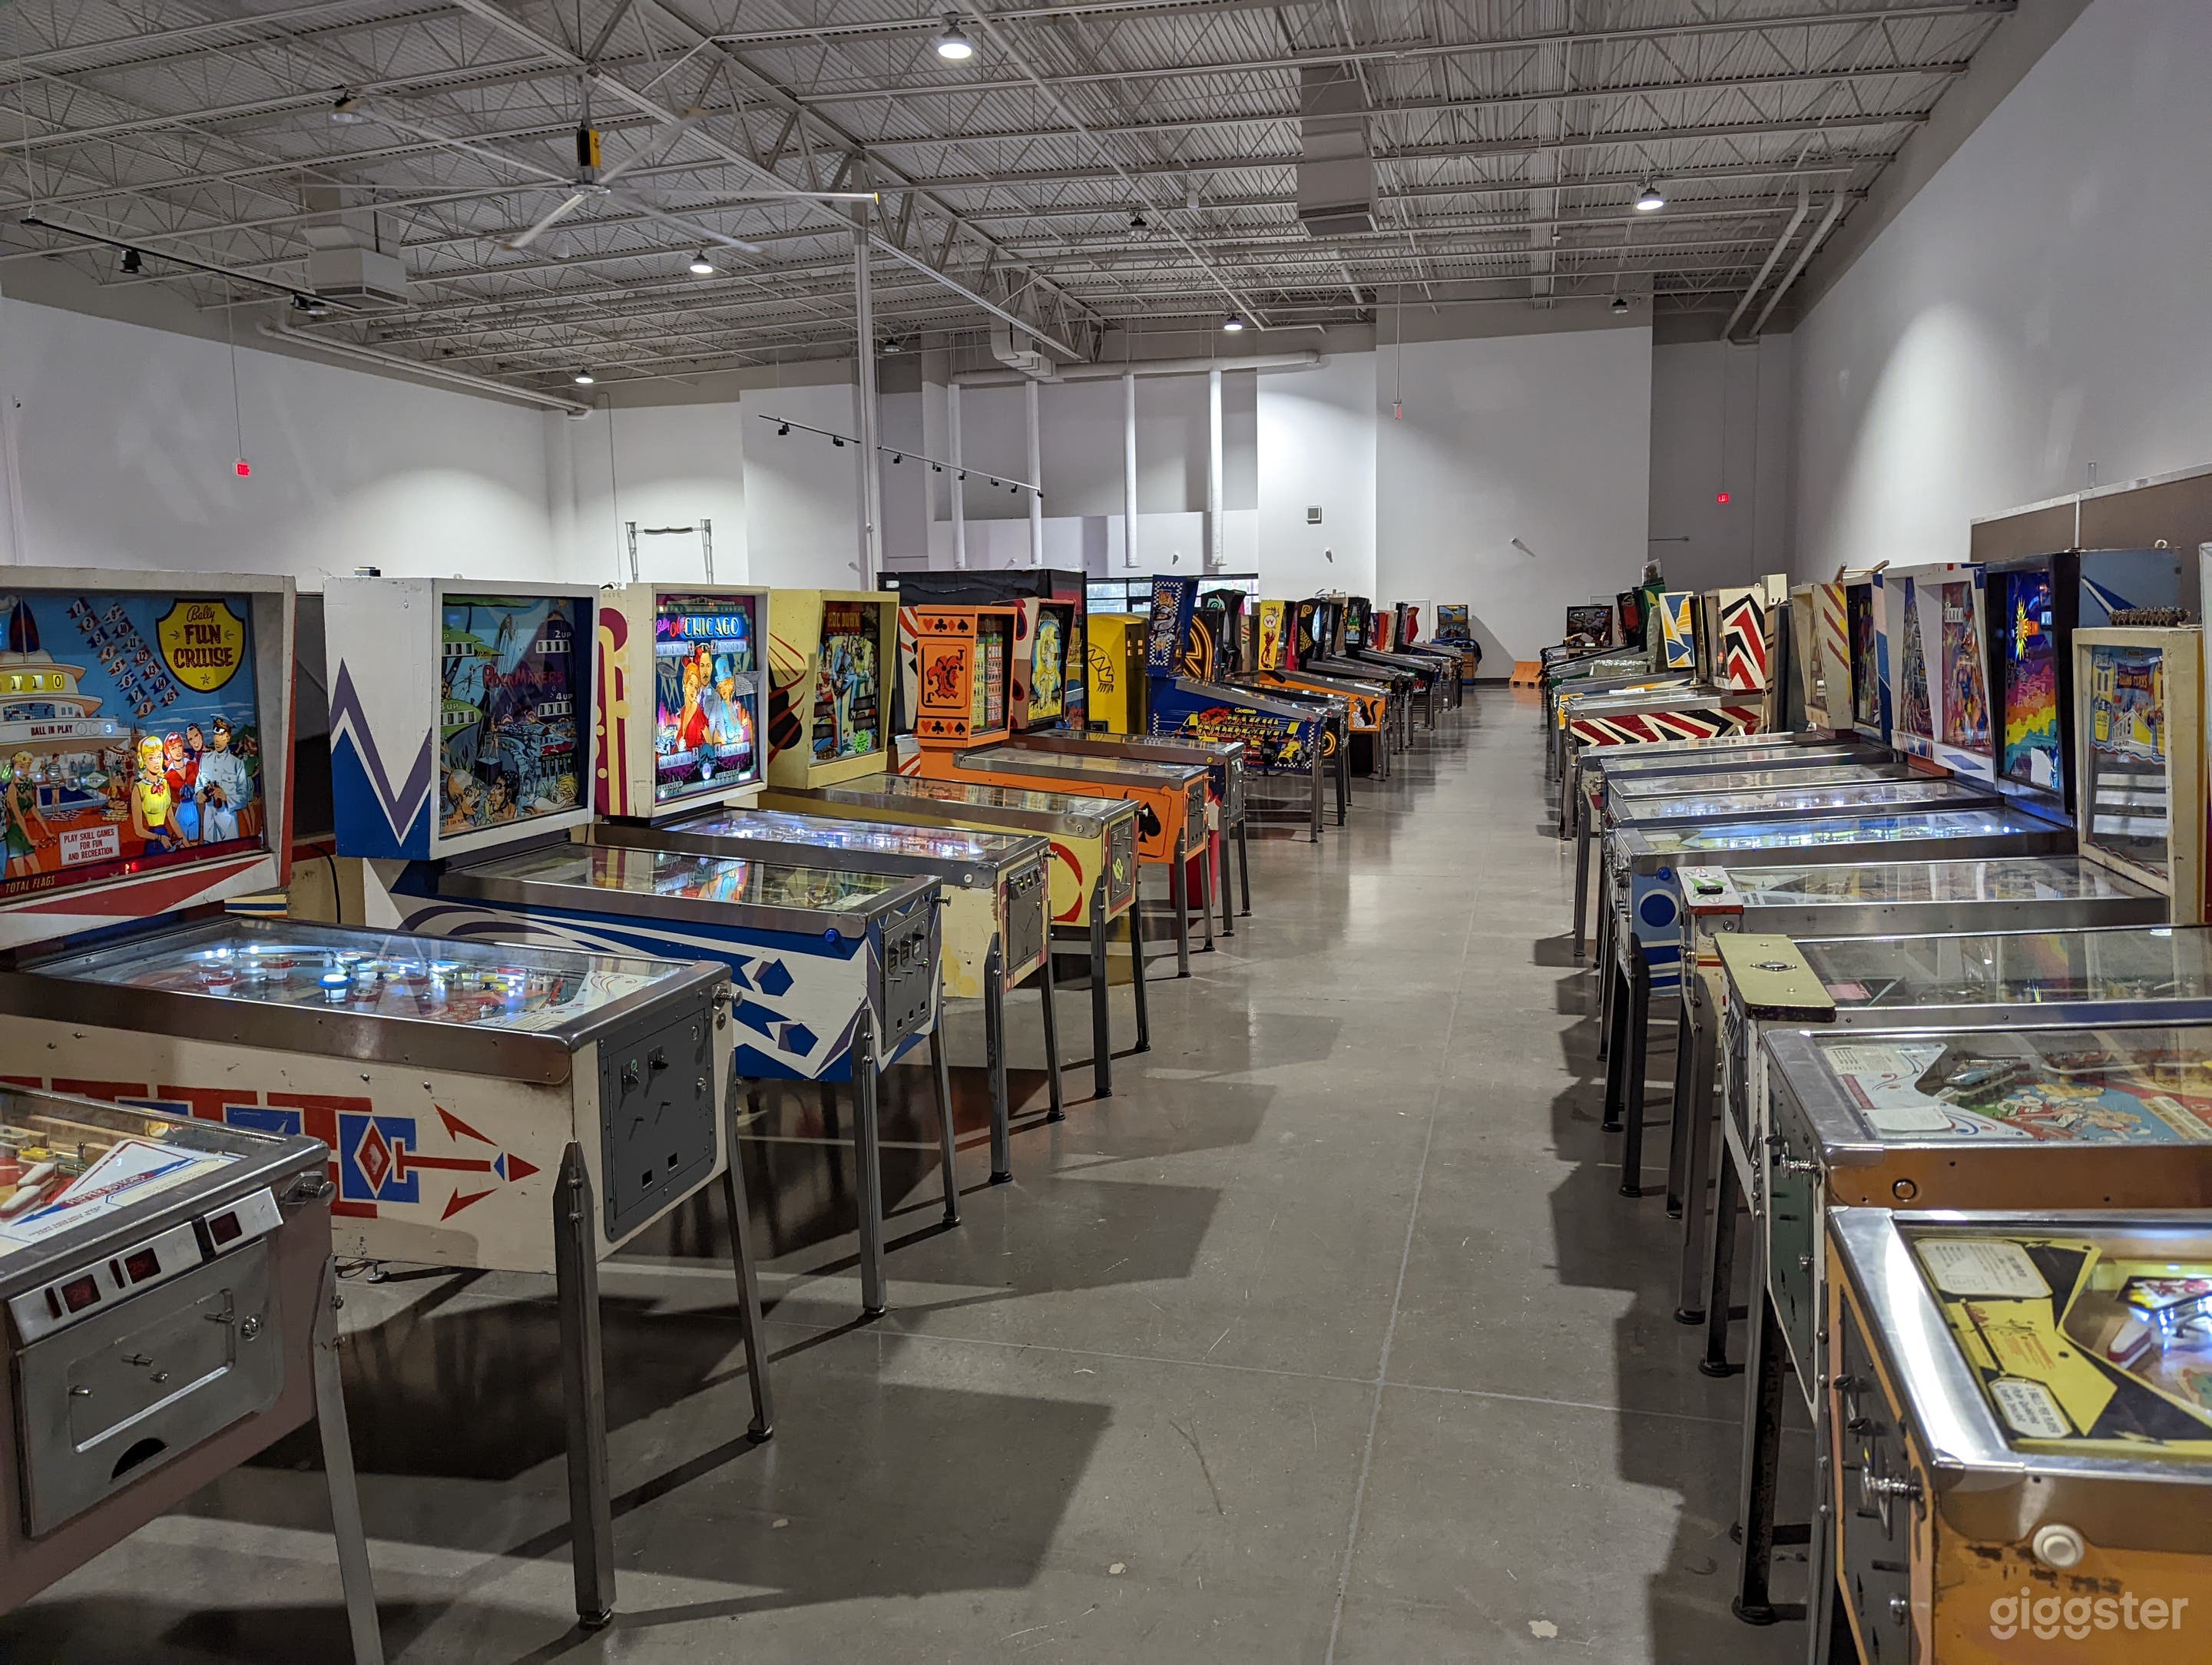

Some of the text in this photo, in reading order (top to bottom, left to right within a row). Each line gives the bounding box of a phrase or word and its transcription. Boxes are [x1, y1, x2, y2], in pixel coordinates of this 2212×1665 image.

[186, 604, 216, 622] Bally
[120, 624, 127, 632] 10
[684, 617, 739, 637] CHICAGO
[184, 624, 221, 645] FUN
[130, 638, 136, 647] 11
[139, 652, 146, 662] 12
[174, 647, 234, 669] CRUISE
[149, 666, 155, 676] 13
[157, 679, 164, 688] 14
[167, 691, 174, 702] 15
[31, 727, 46, 736] BALL
[48, 726, 55, 734] IN
[57, 725, 73, 734] PLAY
[64, 828, 114, 843] PLAY SKILL GAMES
[80, 839, 103, 849] FOR FUN
[68, 846, 114, 862] AND RECREATION
[5, 876, 55, 894] TOTAL FLAGS
